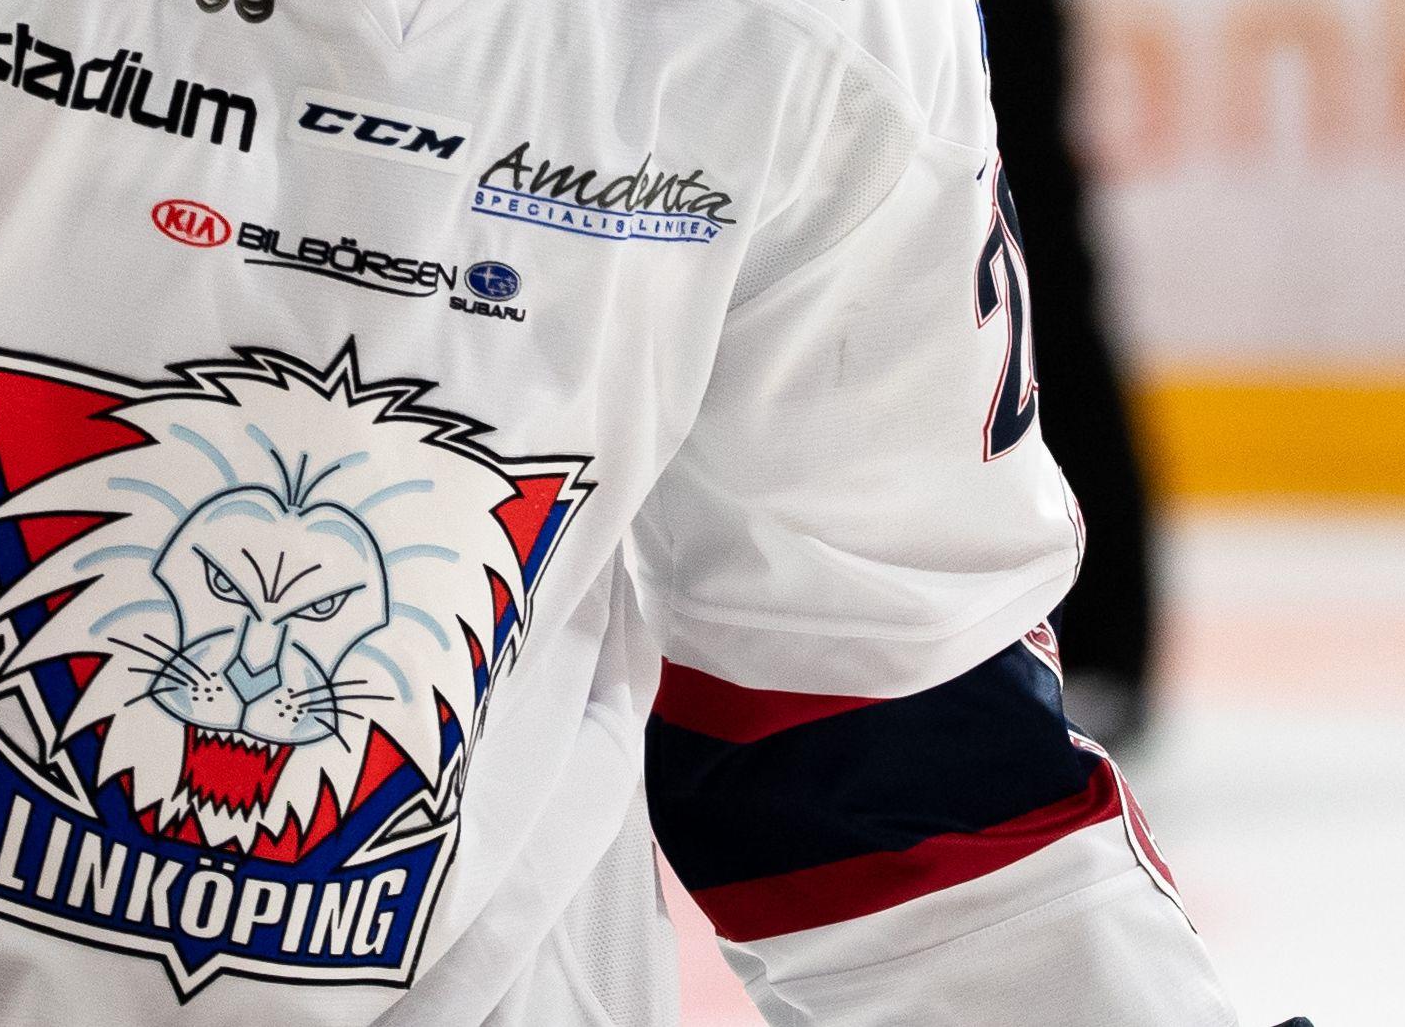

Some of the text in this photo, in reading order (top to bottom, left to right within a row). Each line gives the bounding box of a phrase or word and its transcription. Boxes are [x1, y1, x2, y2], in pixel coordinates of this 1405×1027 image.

[298, 102, 466, 159] CCM
[163, 204, 458, 292] KIA BILBÖRSEN
[449, 296, 527, 323] SUBARU
